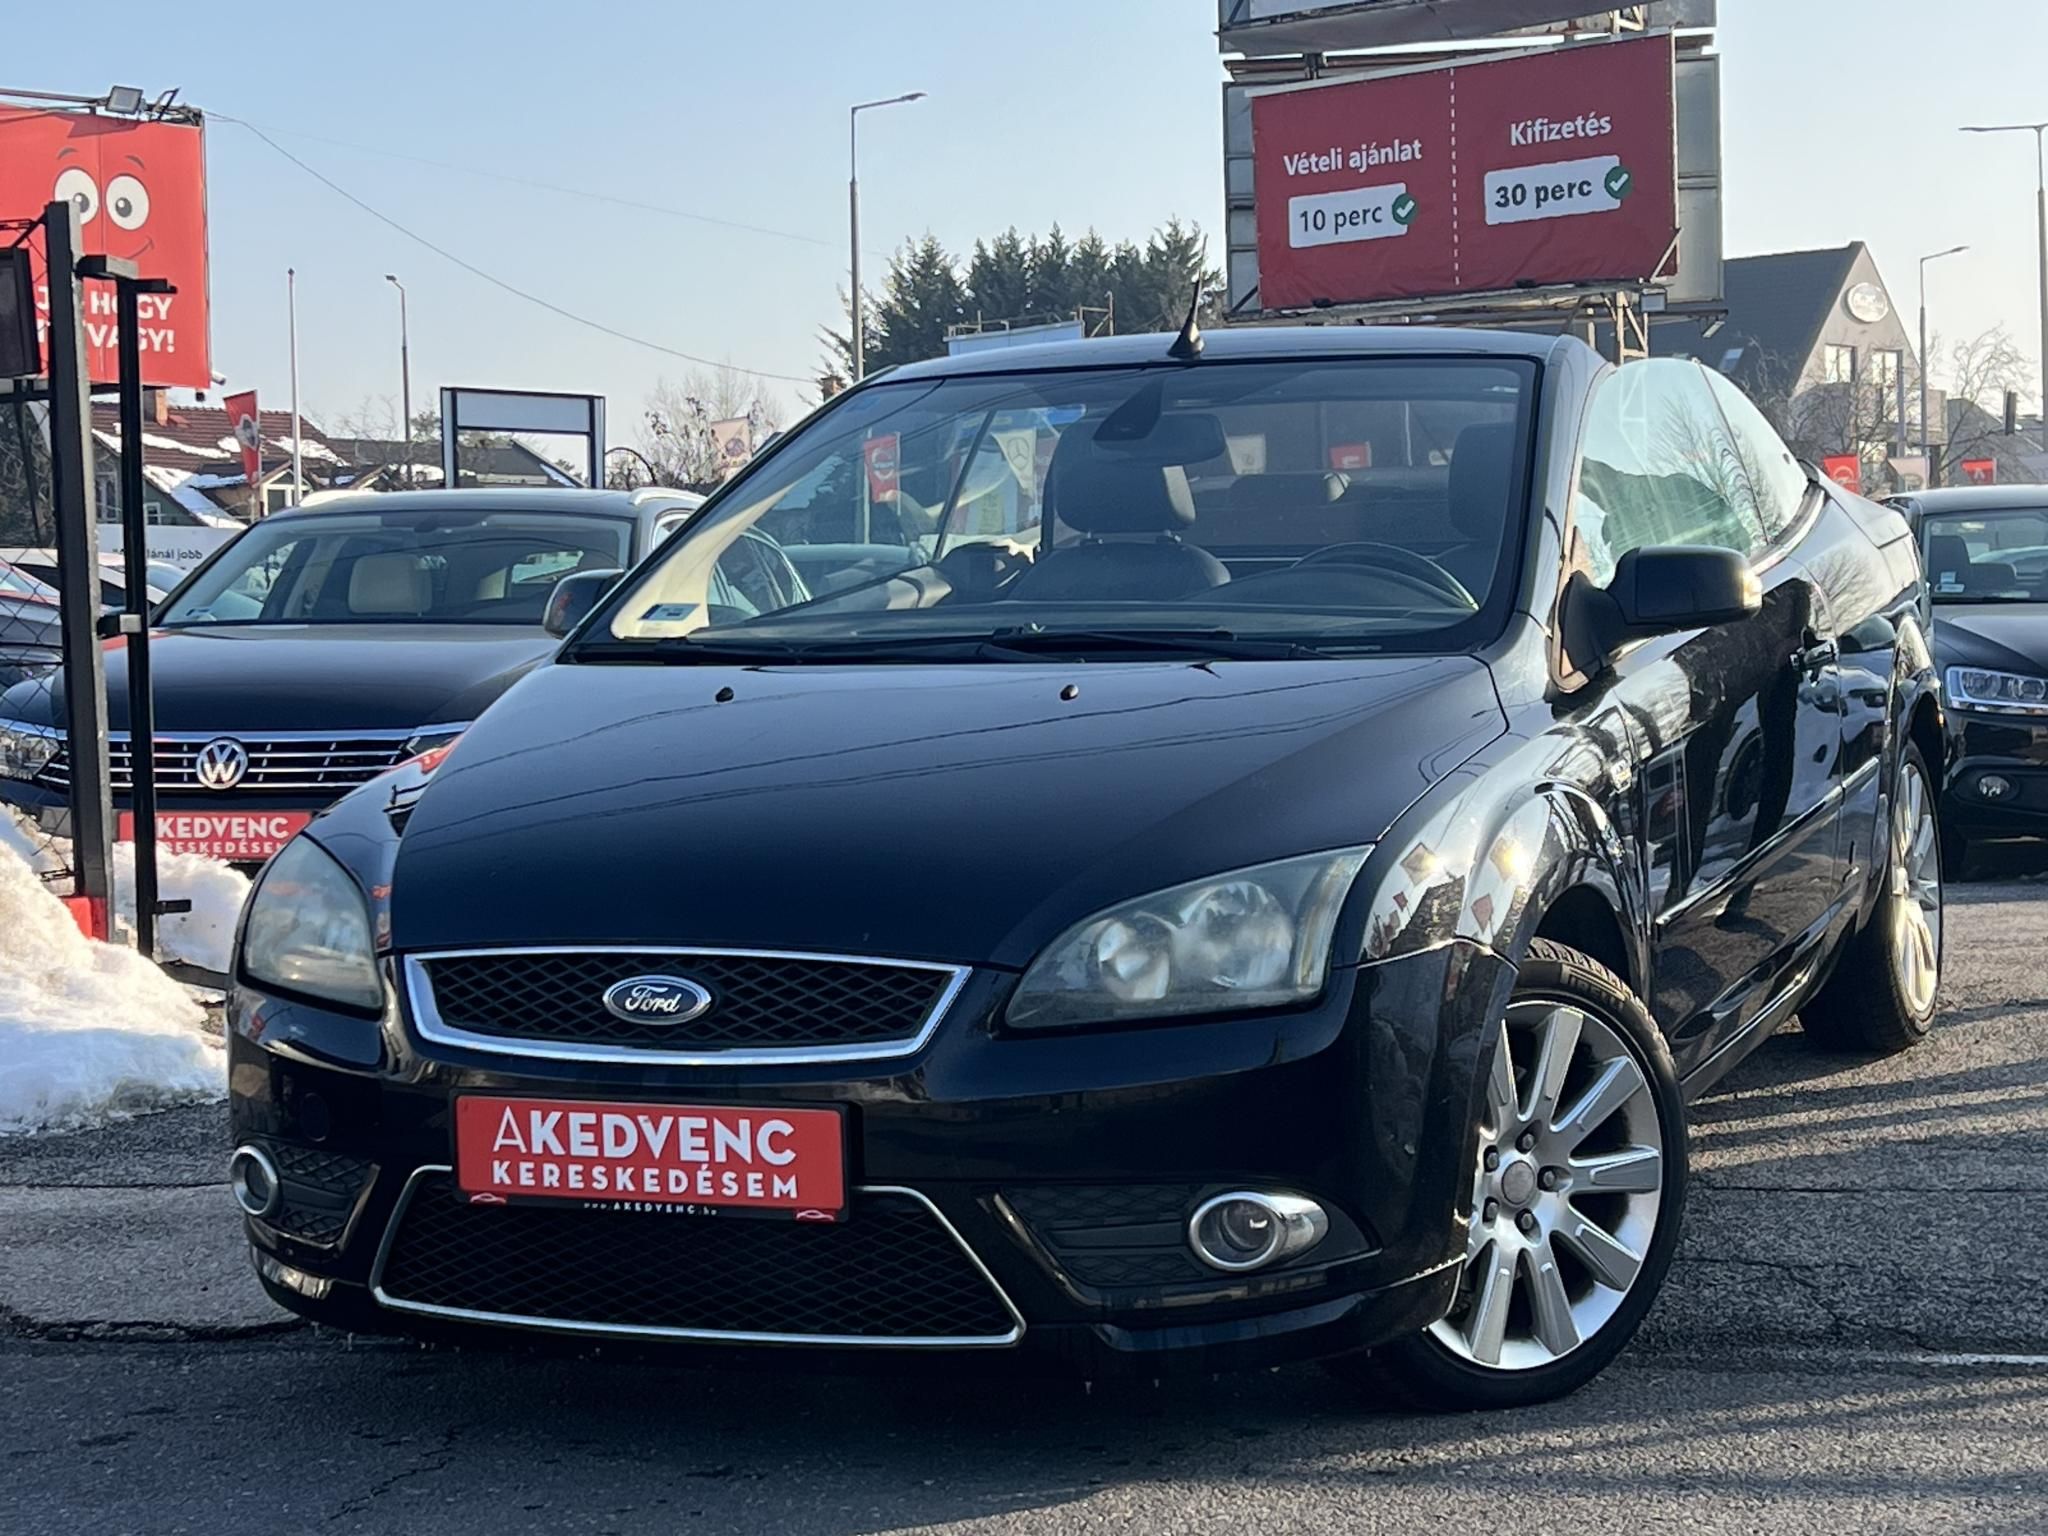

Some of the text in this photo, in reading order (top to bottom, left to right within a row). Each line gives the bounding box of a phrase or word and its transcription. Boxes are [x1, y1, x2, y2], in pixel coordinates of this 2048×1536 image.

[1510, 111, 1612, 146] Kifizetés
[1283, 139, 1423, 176] Vételi ajánlat
[1495, 180, 1592, 209] 30 perc
[1300, 206, 1383, 235] 10 perc
[90, 290, 173, 320] HGY
[177, 548, 203, 562] jobb
[157, 817, 289, 839] KEDVENC
[624, 985, 682, 1013] Ford
[492, 1160, 799, 1199] KERESKEDÉSEM
